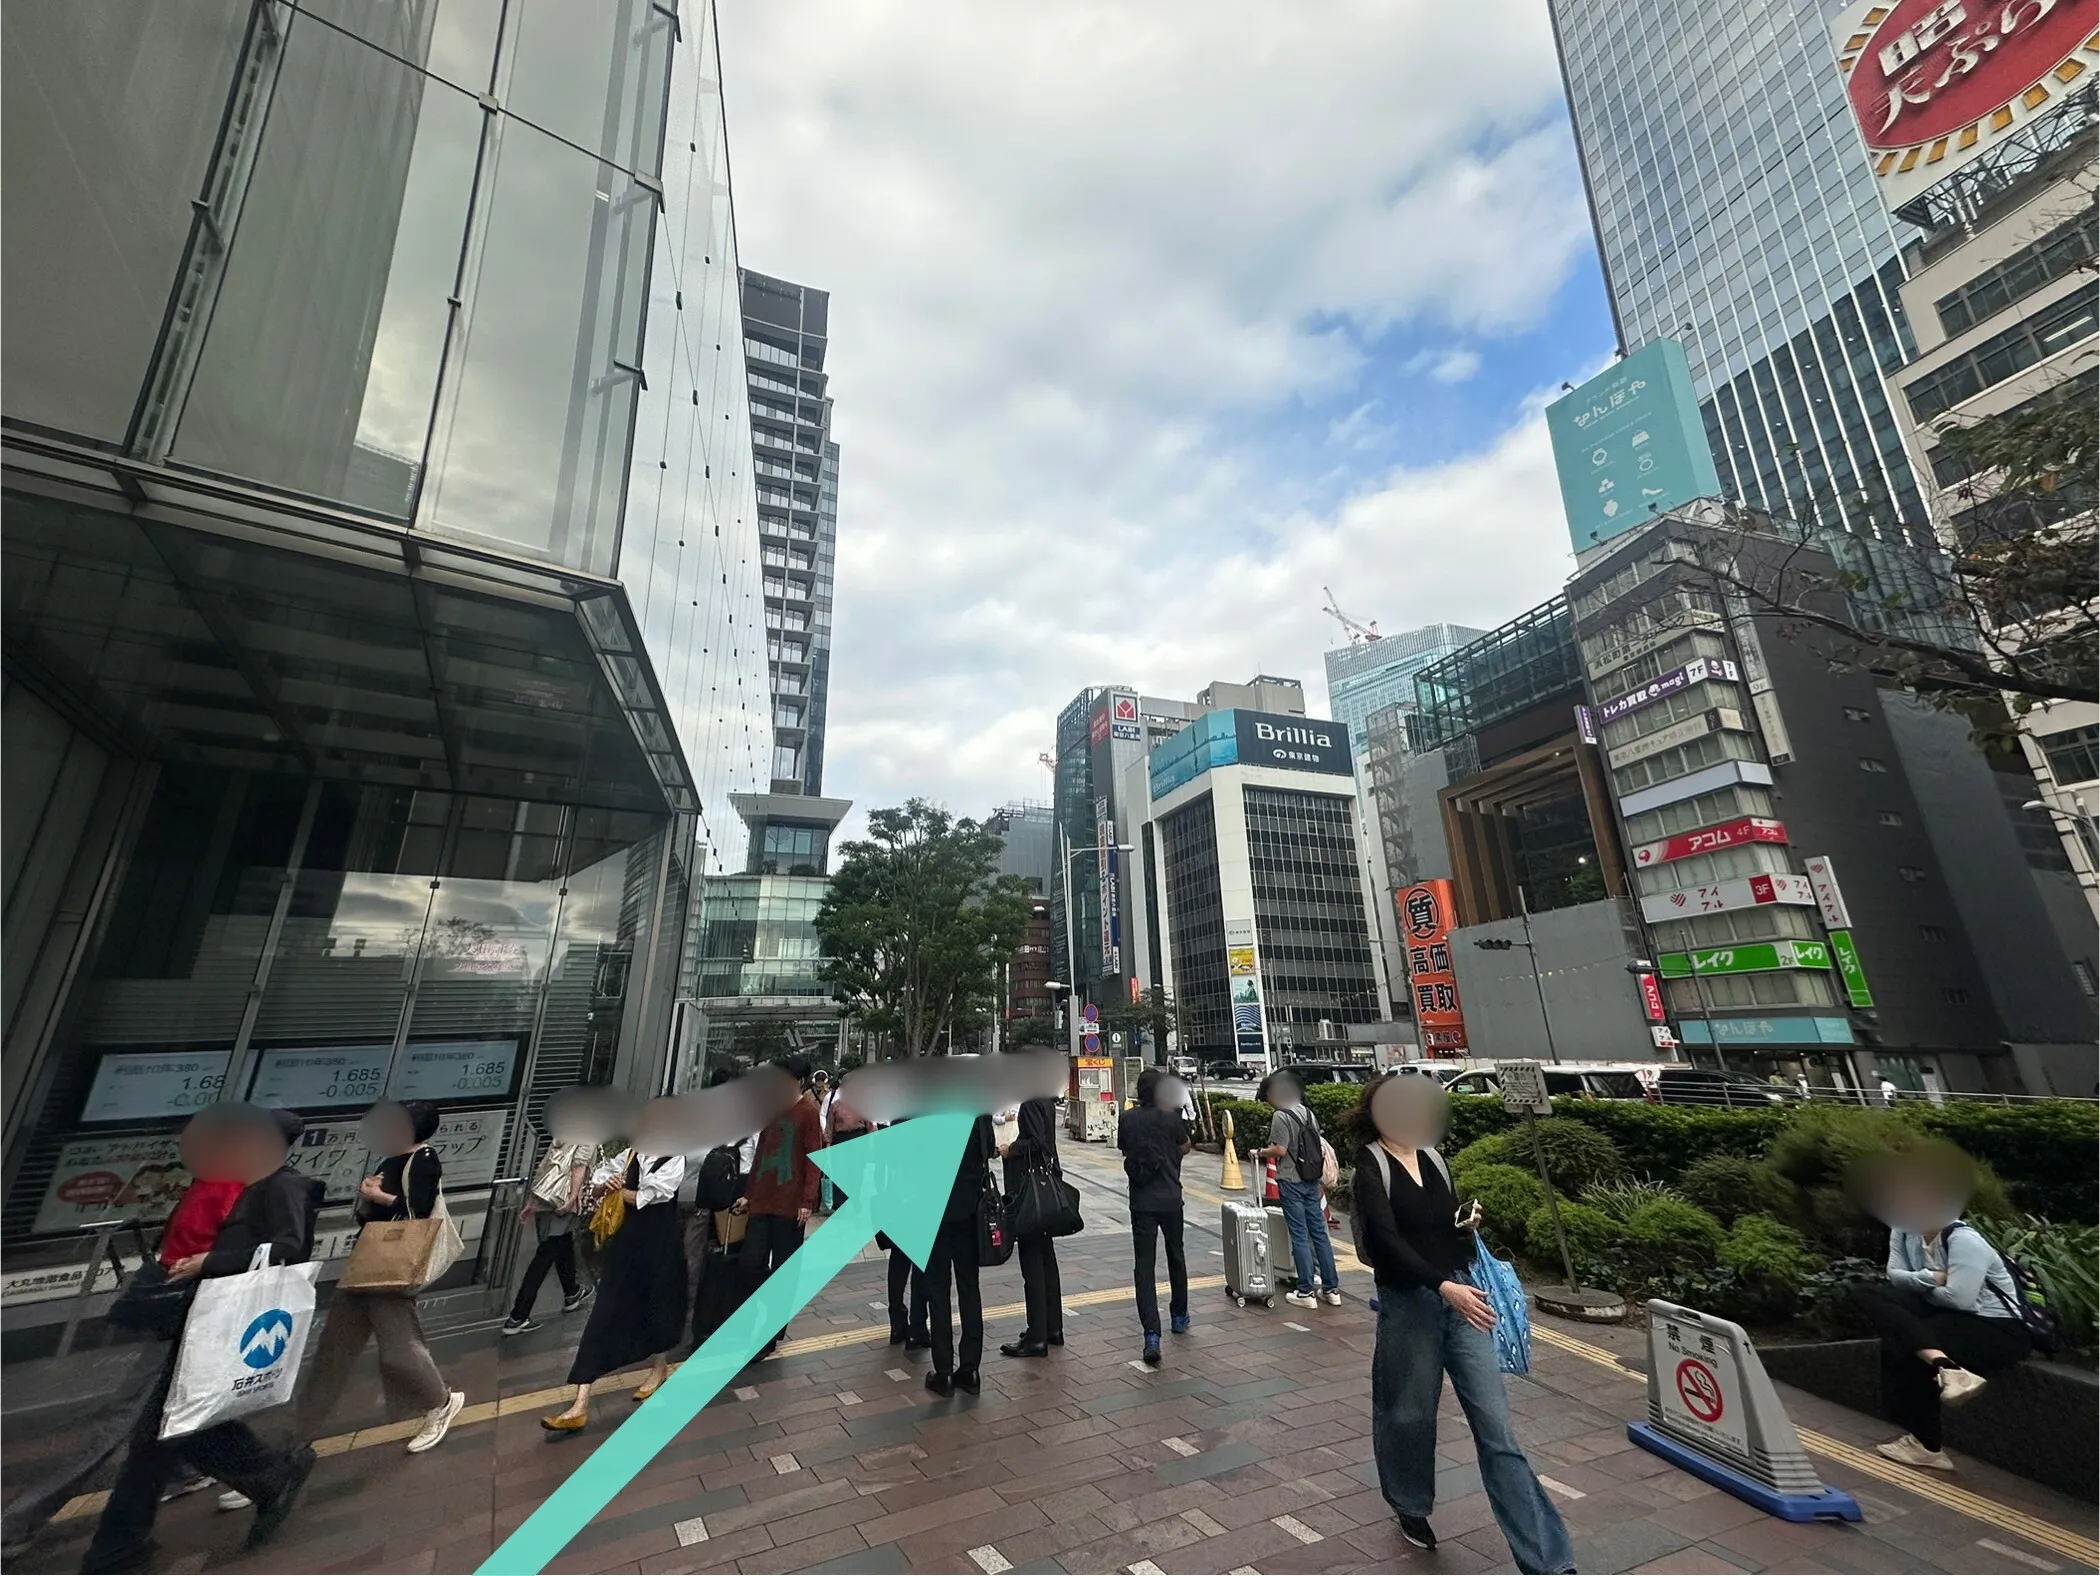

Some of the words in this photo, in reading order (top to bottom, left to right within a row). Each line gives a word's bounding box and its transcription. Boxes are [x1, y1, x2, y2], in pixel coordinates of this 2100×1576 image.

[1572, 380, 1647, 427] なんぼや
[1689, 666, 1704, 677] 7F
[1603, 689, 1648, 718] トレカ買取
[1661, 672, 1684, 691] magi
[1752, 682, 1767, 692] 9F
[1255, 722, 1332, 748] Brillia
[1288, 751, 1320, 763] 東京建物
[1688, 829, 1732, 851] アコム
[1737, 825, 1749, 837] 4F
[1698, 886, 1719, 898] アイ
[1755, 884, 1770, 896] 3F
[1701, 900, 1723, 911] フル
[1817, 884, 1839, 923] アイフル
[1406, 894, 1437, 934] 質
[1409, 943, 1450, 975] 高価
[1692, 950, 1734, 969] レイク
[1780, 956, 1794, 966] 2F
[1794, 945, 1823, 960] レイク
[1839, 947, 1856, 974] レイク
[1417, 983, 1458, 1013] 買取
[1646, 985, 1660, 1010] アコム
[1714, 1019, 1774, 1036] なんぼや
[462, 1061, 506, 1076] 1.685
[1085, 1058, 1106, 1066] 宝くじ
[182, 1075, 226, 1090] 1.68
[332, 1067, 381, 1082] 1.685
[451, 1075, 503, 1090] -0.005
[319, 1082, 378, 1098] -0.005
[432, 1135, 487, 1155] ラップ
[1665, 1323, 1715, 1354] 禁煙
[1668, 1341, 1680, 1353] No
[1681, 1346, 1718, 1369] Smoking
[232, 1367, 283, 1391] 石井スポーツ
